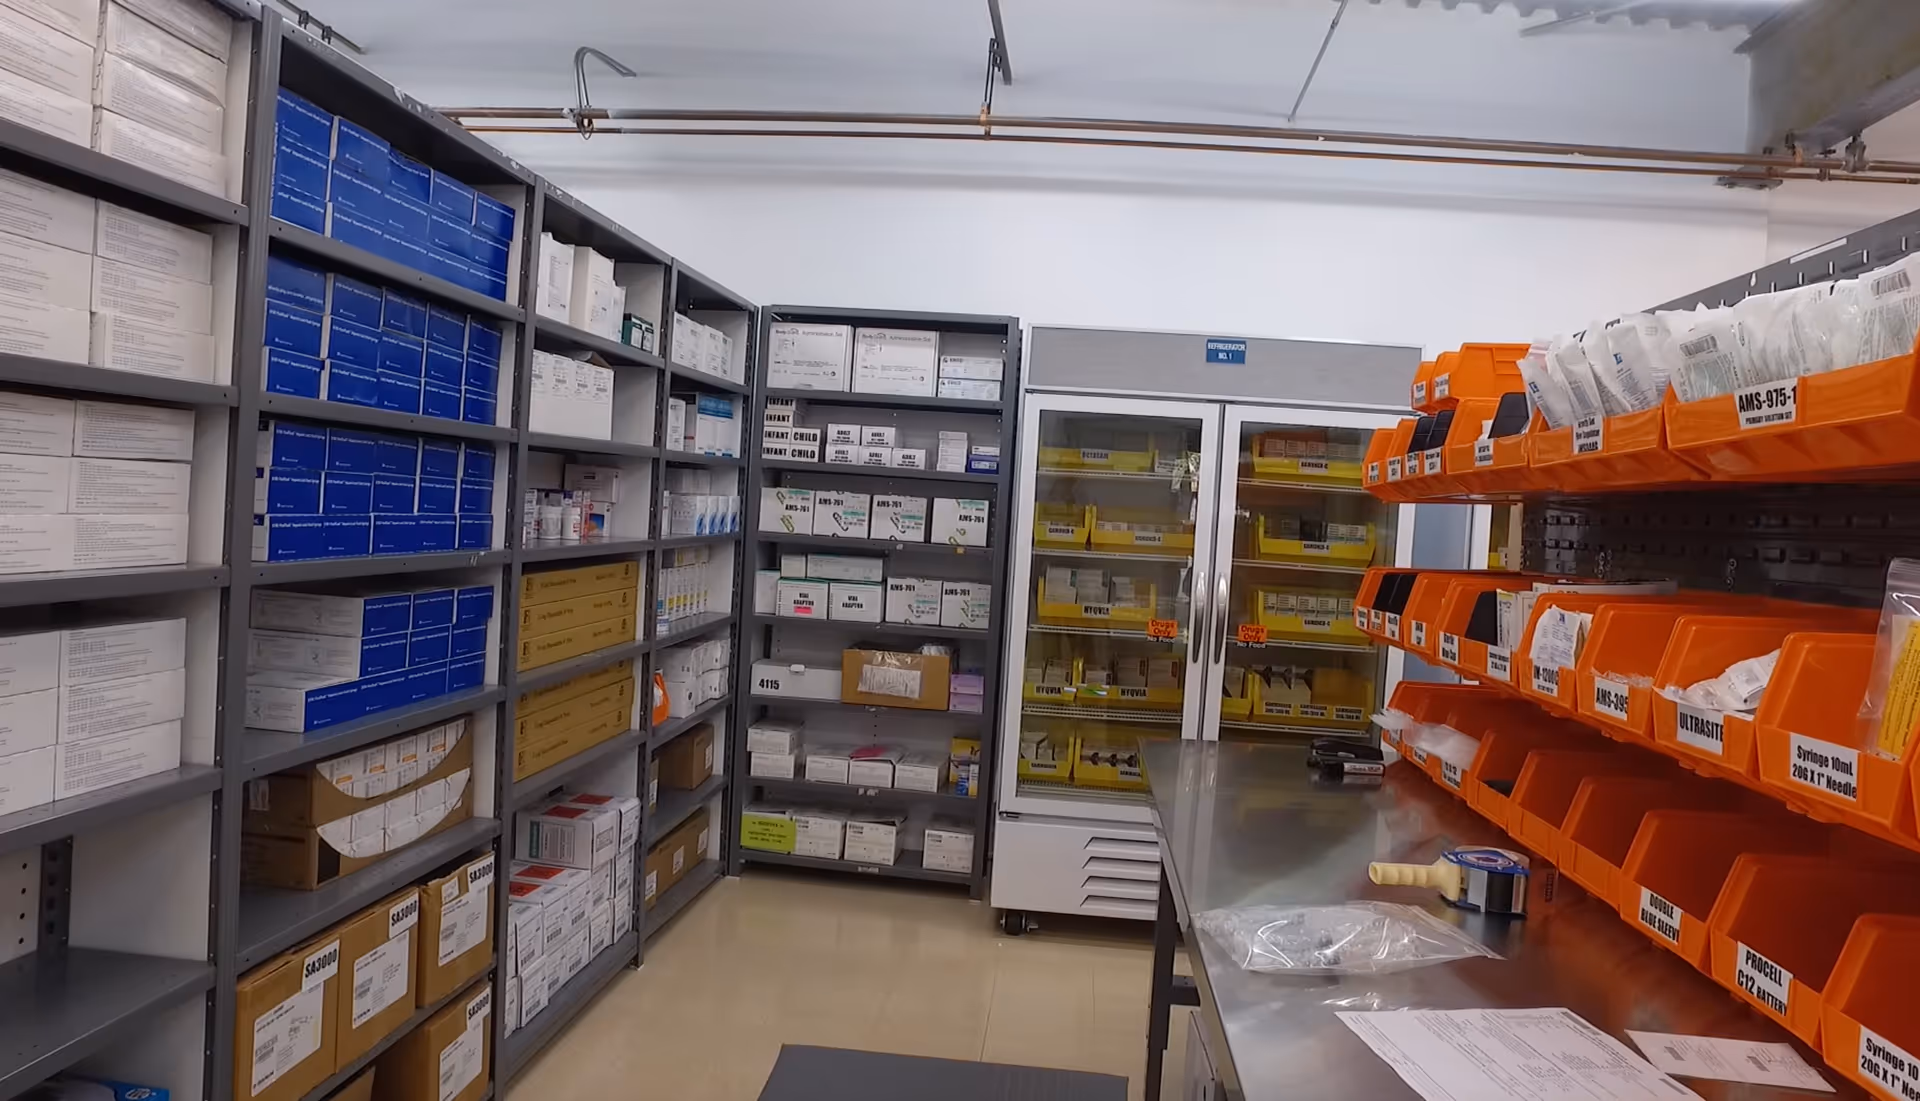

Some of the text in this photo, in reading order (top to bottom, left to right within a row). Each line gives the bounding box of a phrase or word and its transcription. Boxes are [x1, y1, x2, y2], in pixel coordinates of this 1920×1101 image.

[1207, 342, 1247, 352] REFRIGERATOR
[769, 398, 794, 407] INFANT
[1739, 385, 1797, 413] AMS-975-1
[766, 413, 791, 423] INFANT
[764, 430, 790, 440] INFANT
[793, 432, 818, 442] CHILD
[762, 447, 788, 457] INFANT
[791, 448, 816, 459] CHILD
[1151, 620, 1174, 630] Drugs
[1154, 628, 1171, 637] Only
[1241, 625, 1264, 634] Drugs
[1244, 632, 1261, 642] Only
[758, 678, 780, 691] 4115
[1679, 711, 1724, 743] ULTRASITE
[1797, 744, 1854, 777] Syringe 10mL
[1792, 763, 1808, 781] 20G
[1809, 769, 1816, 785] X
[1826, 775, 1858, 800] Needle
[469, 861, 493, 884] SA3000
[391, 900, 418, 927] SA3000
[1650, 893, 1674, 920] DOUBLE
[1641, 907, 1657, 929] BLUE
[305, 948, 338, 978] SA3000
[1745, 949, 1783, 987] PROCELL
[1737, 969, 1788, 1017] C12 BATTERY
[467, 993, 490, 1021] SA3000
[1861, 1054, 1880, 1078] 20G
[1882, 1067, 1889, 1085] X
[1866, 1037, 1920, 1081] Syringe 10
